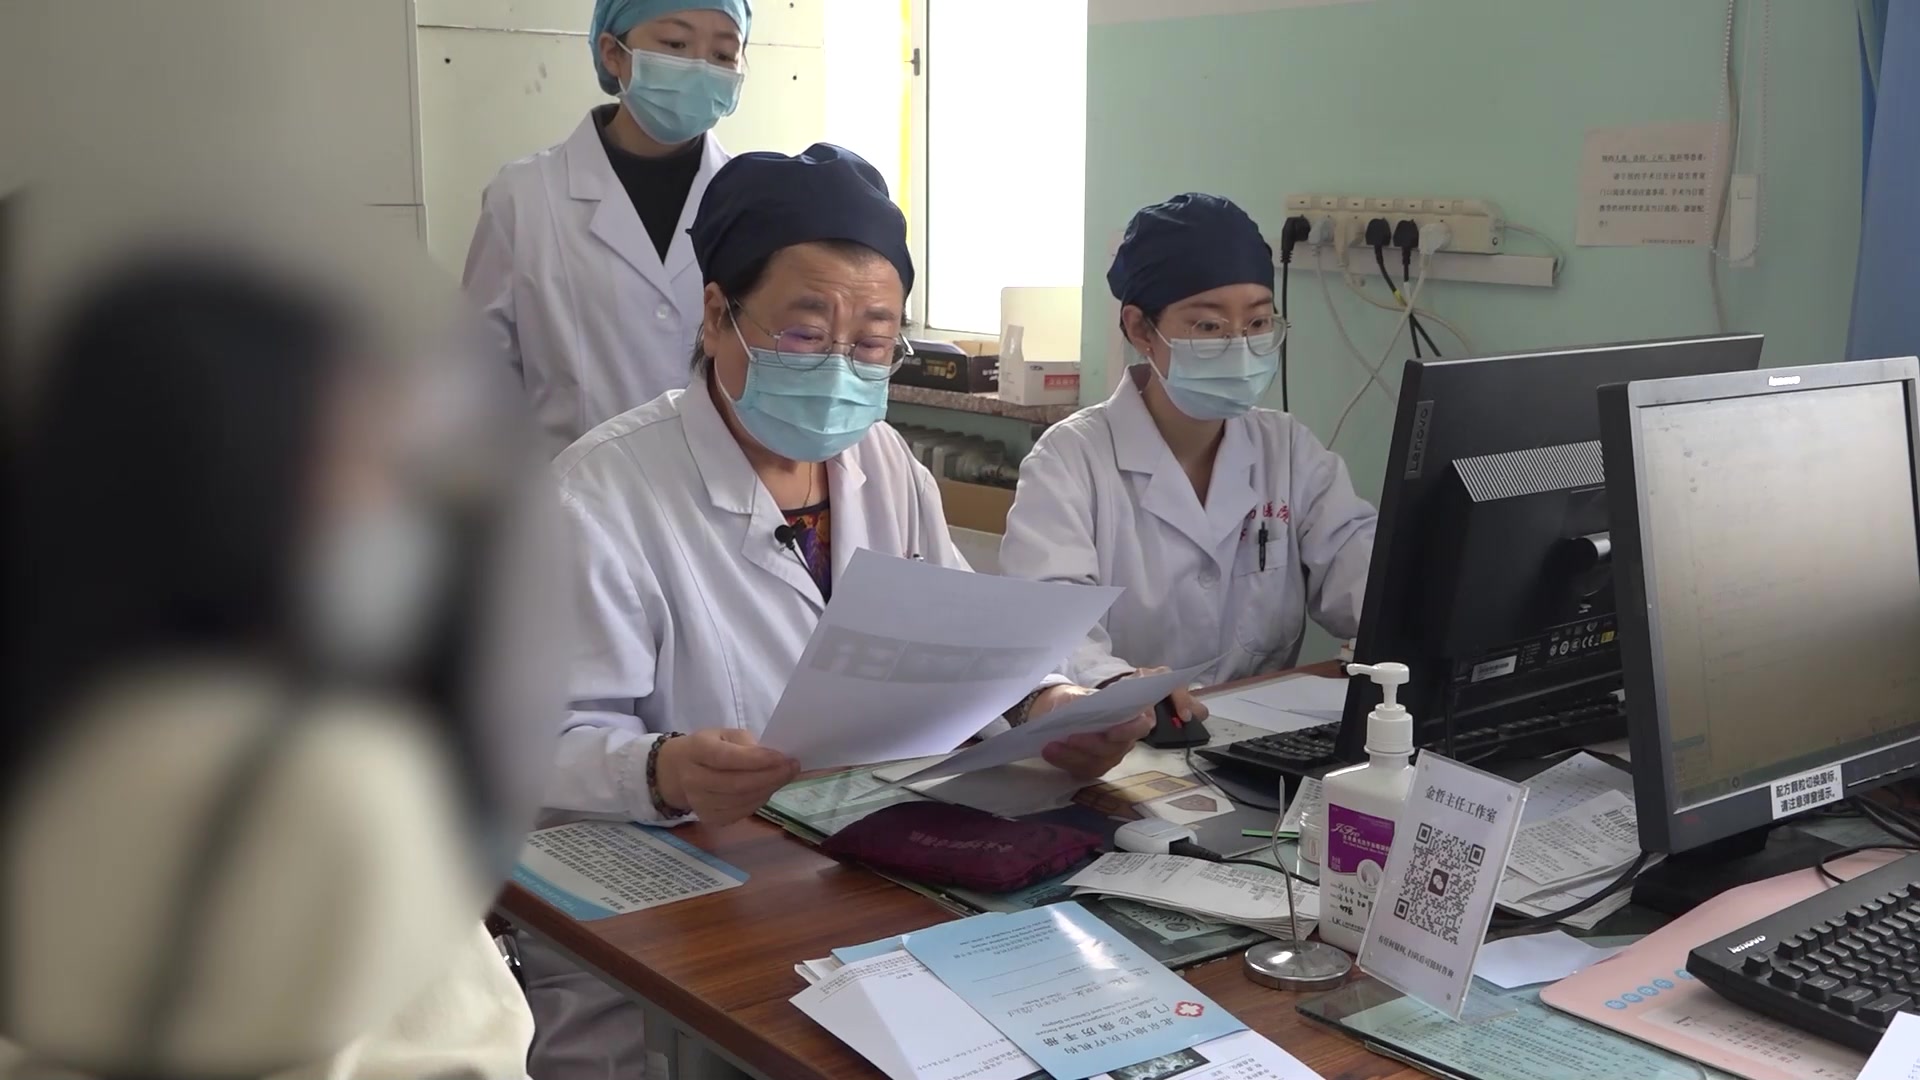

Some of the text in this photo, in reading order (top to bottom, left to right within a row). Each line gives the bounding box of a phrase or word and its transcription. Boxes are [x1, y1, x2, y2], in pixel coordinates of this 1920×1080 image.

[1408, 407, 1429, 473] Lenovo
[1425, 785, 1497, 824] 金哲主任工作室
[1727, 935, 1766, 954] lenovo
[1043, 1003, 1171, 1047] 门急诊病历手册
[1064, 1017, 1174, 1055] 北京地区医疗机构
